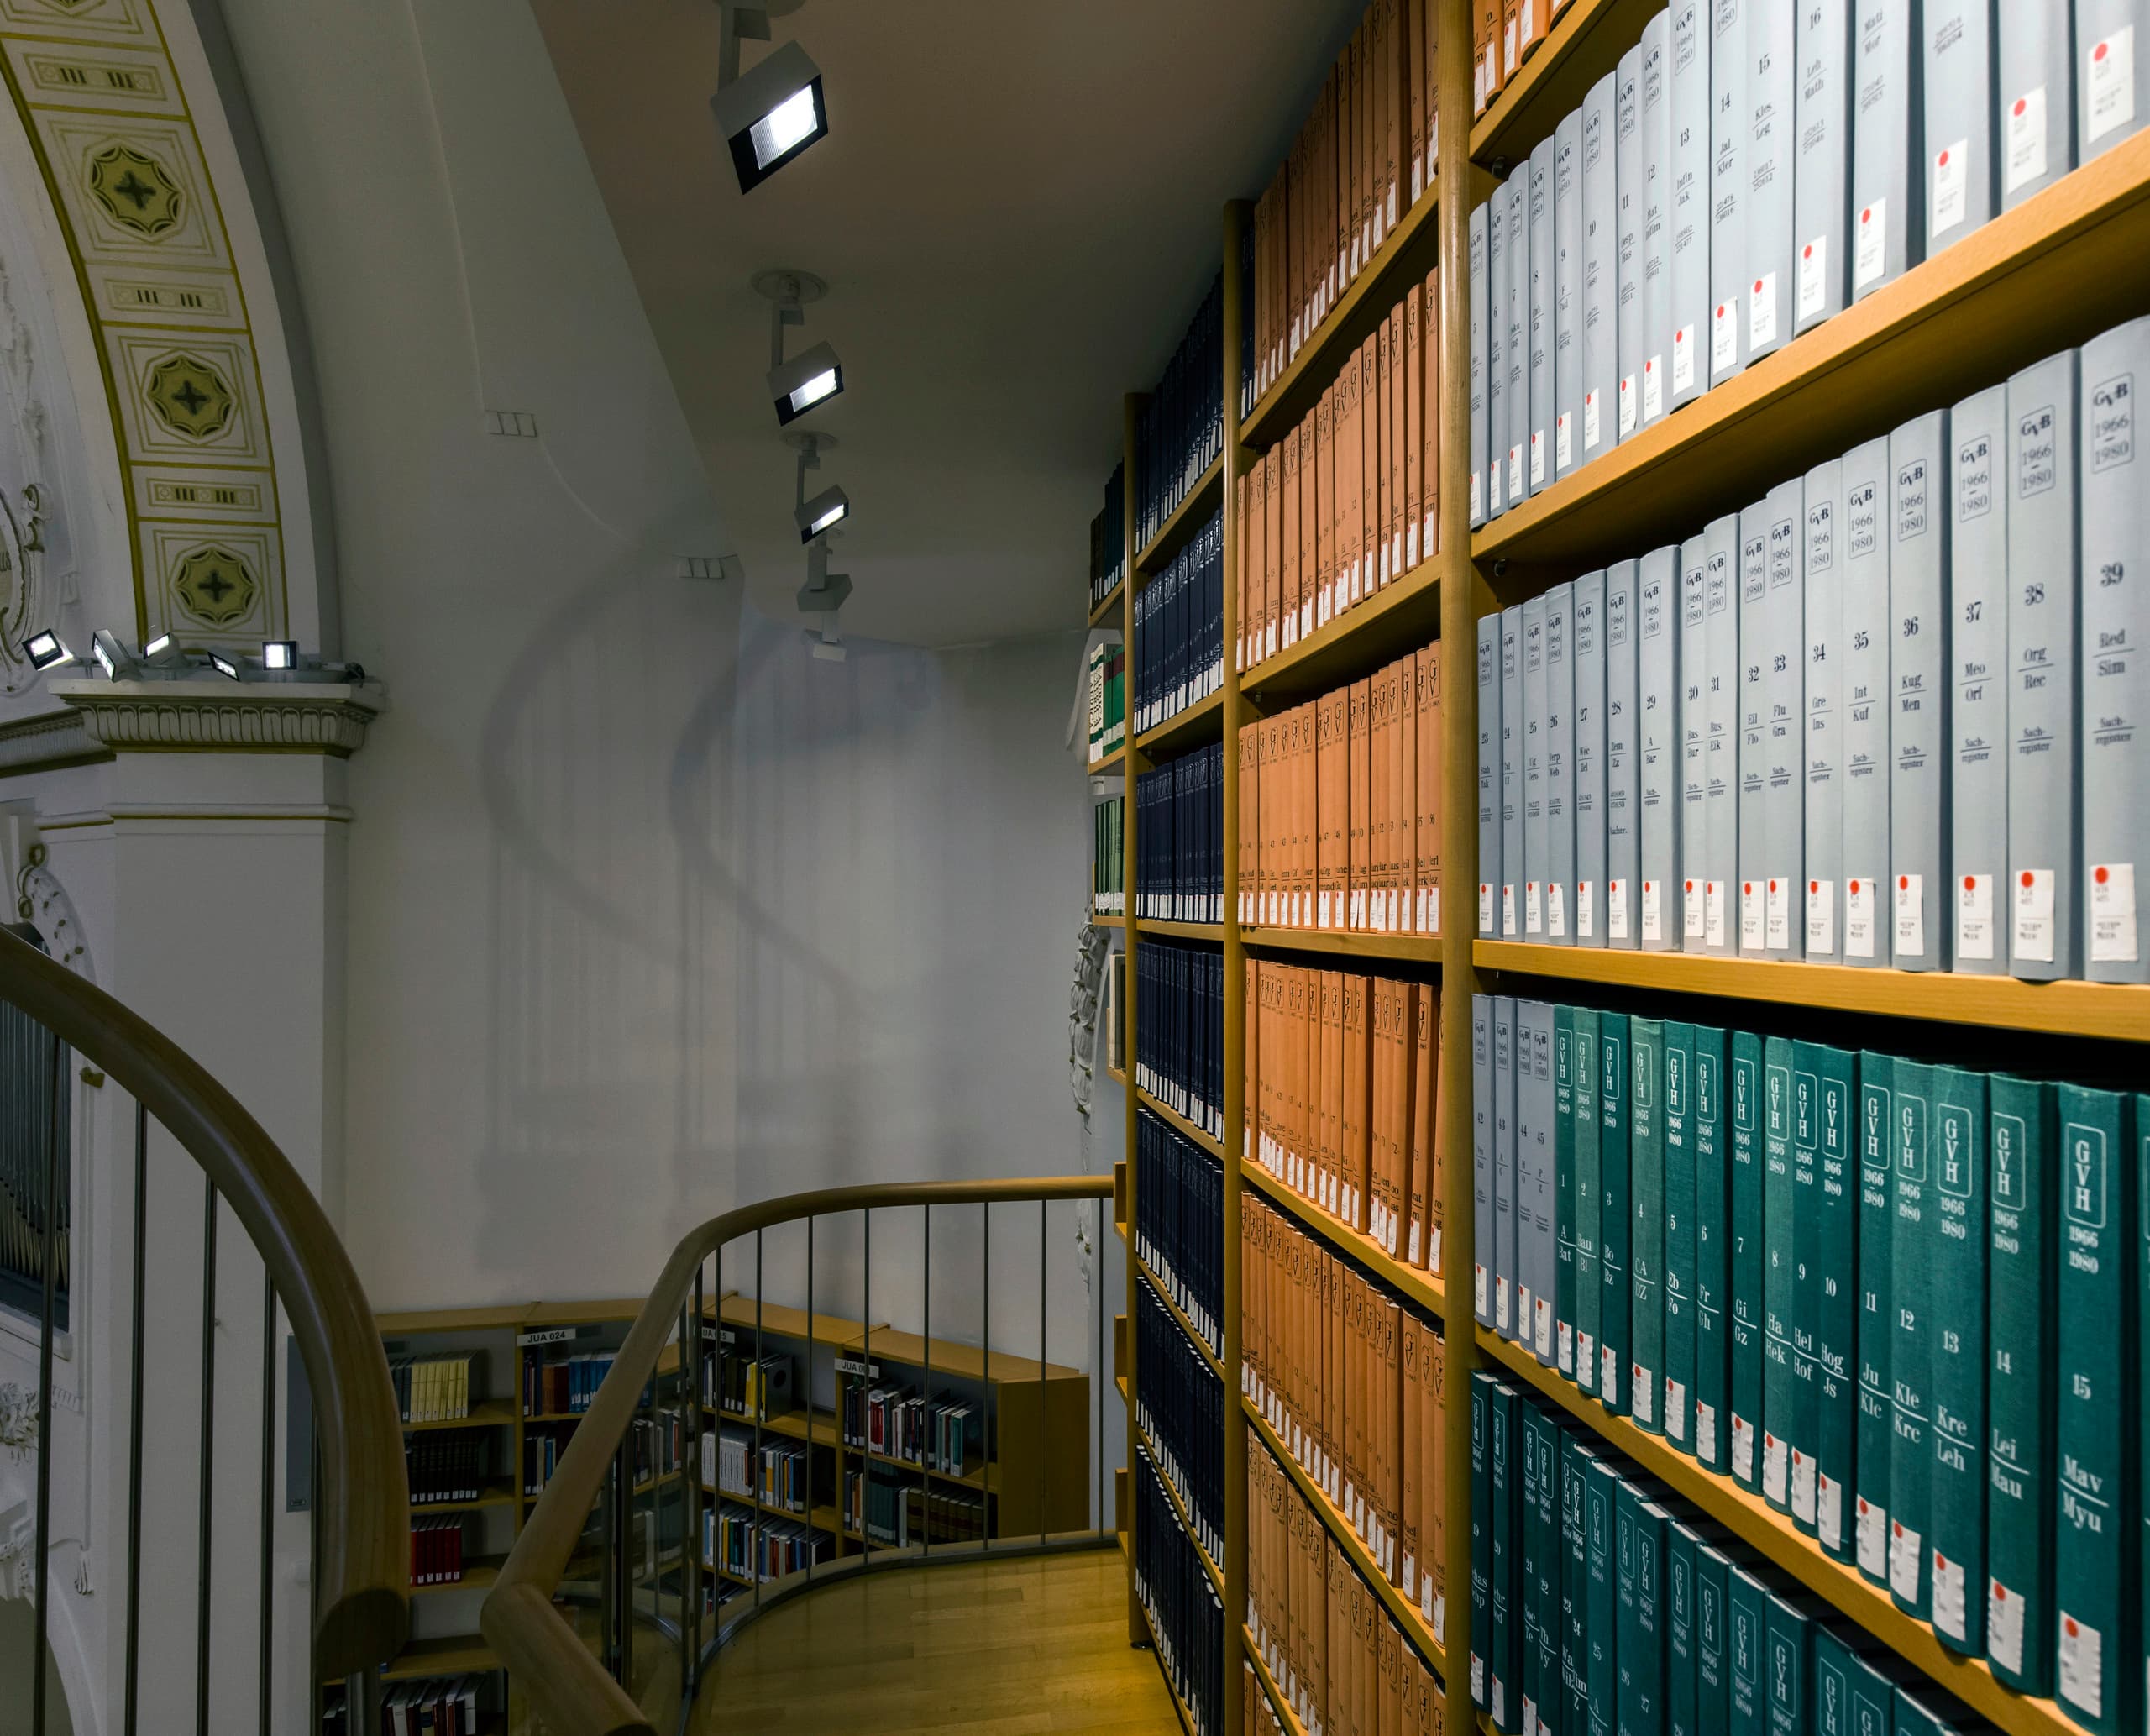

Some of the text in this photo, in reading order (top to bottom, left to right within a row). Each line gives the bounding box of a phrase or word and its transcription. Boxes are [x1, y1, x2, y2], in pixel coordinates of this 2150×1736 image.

[1810, 7, 1821, 30] 16
[1759, 54, 1770, 76] 15
[1721, 93, 1730, 113] 14
[1680, 128, 1689, 147] 13
[1648, 165, 1655, 181] 12
[1623, 193, 1628, 210] 11
[1589, 221, 1596, 237] 10
[1561, 249, 1565, 262] 9
[2095, 416, 2129, 438] 1966
[2022, 443, 2052, 464] 1966
[2095, 442, 2129, 464] 1980
[1962, 472, 1987, 492] 1966
[2022, 471, 2052, 490] 1980
[1901, 494, 1923, 511] 1966
[1962, 495, 1987, 514] 1980
[1901, 516, 1923, 534] 1980
[2100, 562, 2124, 587] 39
[2024, 583, 2045, 606] 38
[1965, 601, 1982, 623] 37
[1903, 616, 1919, 637] 36
[1854, 630, 1869, 651] 35
[1813, 643, 1826, 663] 34
[2023, 647, 2047, 663] Org
[1774, 654, 1786, 672] 33
[1965, 662, 1986, 677] Meo
[1711, 675, 1720, 692] 31
[1749, 666, 1759, 683] 32
[1902, 674, 1922, 689] Kug
[2024, 674, 2046, 690] Rec
[1688, 685, 1698, 701] 30
[1854, 685, 1867, 700] Int
[1965, 686, 1983, 702] Orf
[1647, 695, 1657, 710] 29
[1812, 697, 1827, 708] Gre
[1902, 699, 1920, 712] Men
[1853, 706, 1869, 722] Kuf
[1772, 726, 1786, 737] Gra
[1812, 719, 1825, 731] Ins
[1562, 1175, 1565, 1187] 1
[1581, 1183, 1586, 1196] 2
[1607, 1192, 1612, 1205] 3
[1940, 1197, 1965, 1216] 1966
[1638, 1204, 1644, 1218] 4
[1994, 1209, 2018, 1230] 1966
[1561, 1225, 1566, 1238] A
[1670, 1214, 1675, 1230] 5
[1941, 1219, 1965, 1240] 1980
[1576, 1233, 1592, 1251] Bau
[1701, 1225, 1707, 1241] 6
[2069, 1225, 2099, 1248] 1966
[1559, 1246, 1571, 1261] Bat
[1605, 1245, 1614, 1261] Bo
[1738, 1237, 1744, 1253] 7
[1994, 1233, 2019, 1255] 1980
[1635, 1258, 1647, 1276] CA
[1772, 1250, 1778, 1267] 8
[2069, 1251, 2099, 1274] 1980
[1604, 1268, 1613, 1285] Bz
[1668, 1271, 1679, 1290] Eb
[1799, 1263, 1806, 1280] 9
[1635, 1283, 1647, 1300] DZ
[1699, 1284, 1710, 1303] Fr
[1825, 1277, 1837, 1297] 10
[1668, 1296, 1678, 1314] Fo
[1735, 1298, 1747, 1319] Gi
[1865, 1291, 1877, 1313] 11
[1698, 1310, 1711, 1330] Gh
[1768, 1312, 1783, 1335] Ha
[1900, 1309, 1914, 1331] 12
[528, 1331, 565, 1343] JUA 024
[1735, 1324, 1747, 1345] Gz
[1795, 1327, 1812, 1351] Hel
[1943, 1330, 1959, 1354] 13
[1765, 1339, 1786, 1364] Hek
[1821, 1342, 1843, 1375] Hog
[842, 1361, 857, 1371] JUA
[1794, 1356, 1812, 1381] Hof
[1995, 1349, 2011, 1375] 14
[1863, 1362, 1879, 1386] Ju
[1823, 1377, 1837, 1398] Js
[1895, 1380, 1919, 1409] Kle
[2073, 1373, 2091, 1400] 15
[1860, 1390, 1881, 1419] Klc
[1893, 1412, 1920, 1443] Krc
[1937, 1404, 1967, 1436] Kre
[1993, 1428, 2016, 1460] Lei
[1936, 1438, 1965, 1471] Leh
[1990, 1461, 2023, 1500] Mau
[2063, 1454, 2103, 1493] Mav
[2063, 1491, 2102, 1534] Myu
[1573, 1618, 1581, 1636] 24
